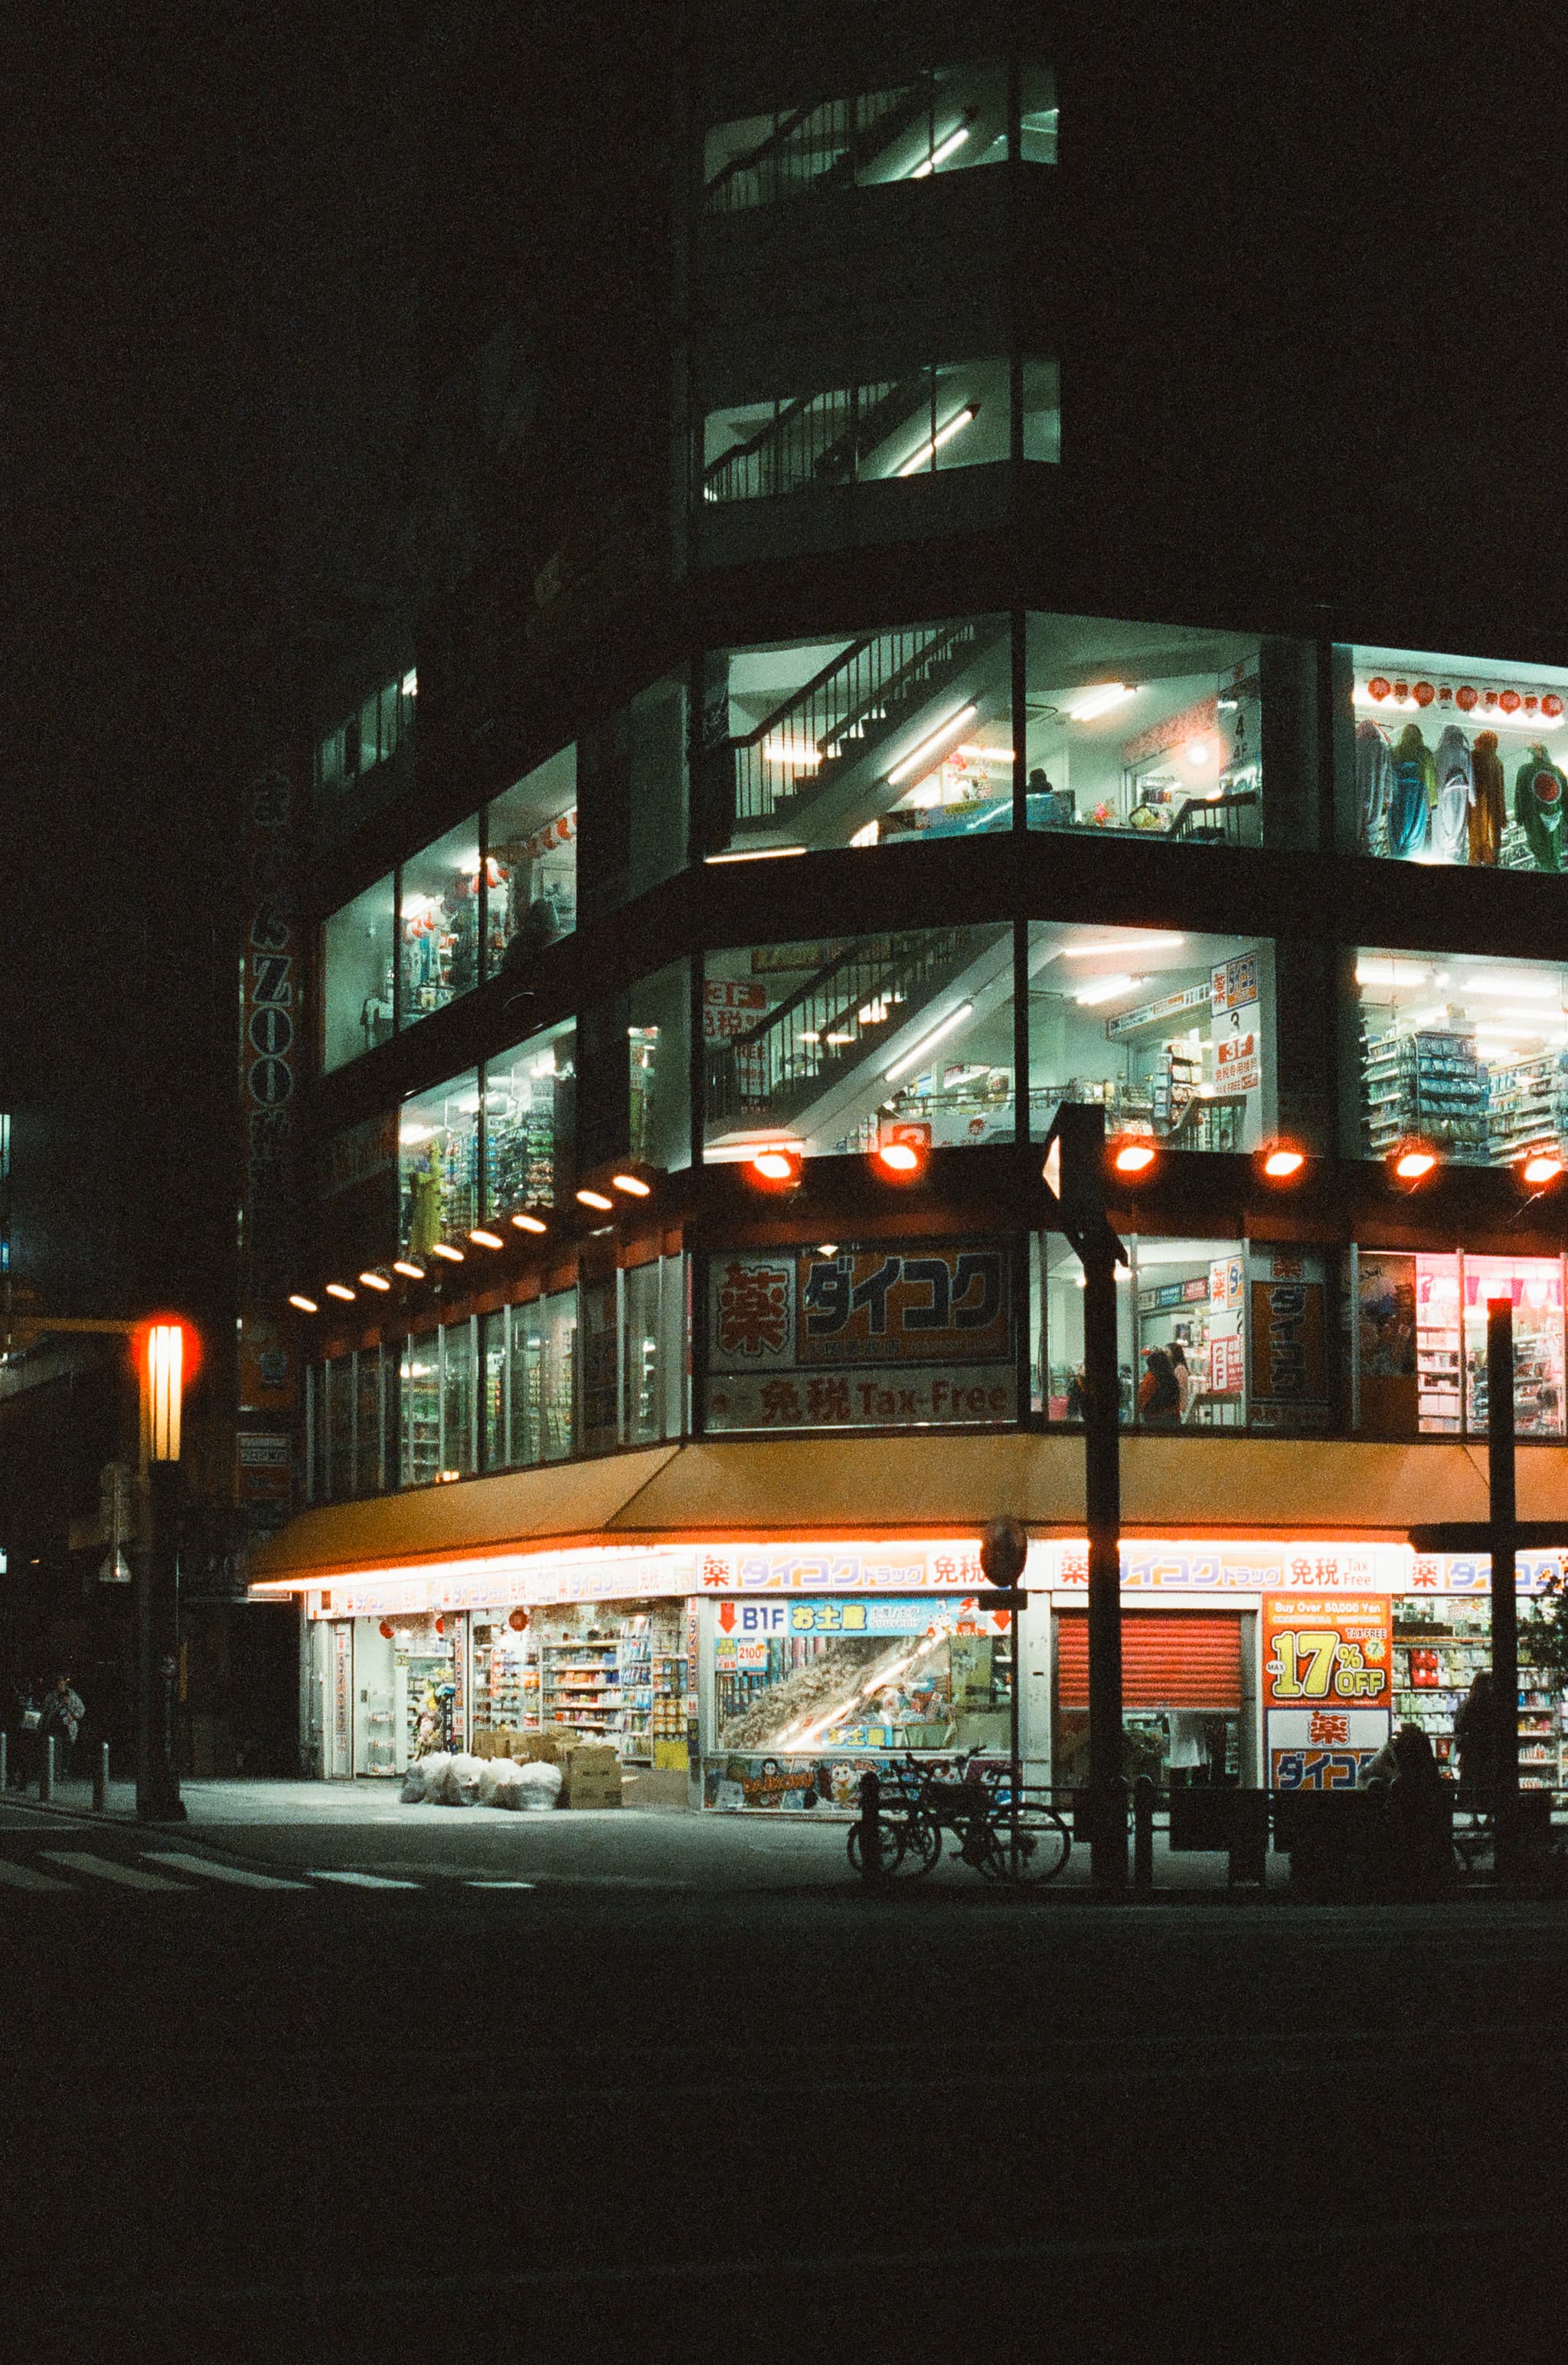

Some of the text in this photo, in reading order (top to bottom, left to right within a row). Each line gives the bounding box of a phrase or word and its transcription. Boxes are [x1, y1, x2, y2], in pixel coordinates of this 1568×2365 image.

[707, 982, 750, 1005] 3F
[718, 1253, 1000, 1356] 薬 ダイコク
[857, 1377, 1008, 1416] Tax-Free
[703, 1554, 730, 1587] 薬
[1290, 1557, 1339, 1586] 免税
[1348, 1557, 1368, 1571] Tax
[1344, 1572, 1372, 1586] Free
[1412, 1559, 1439, 1588] 薬
[743, 1607, 785, 1630] B1F
[792, 1605, 867, 1630] お土産
[1275, 1602, 1382, 1614] Buy Over 50,000 Yen
[1337, 1671, 1383, 1694] OFF
[1308, 1710, 1350, 1746] 薬
